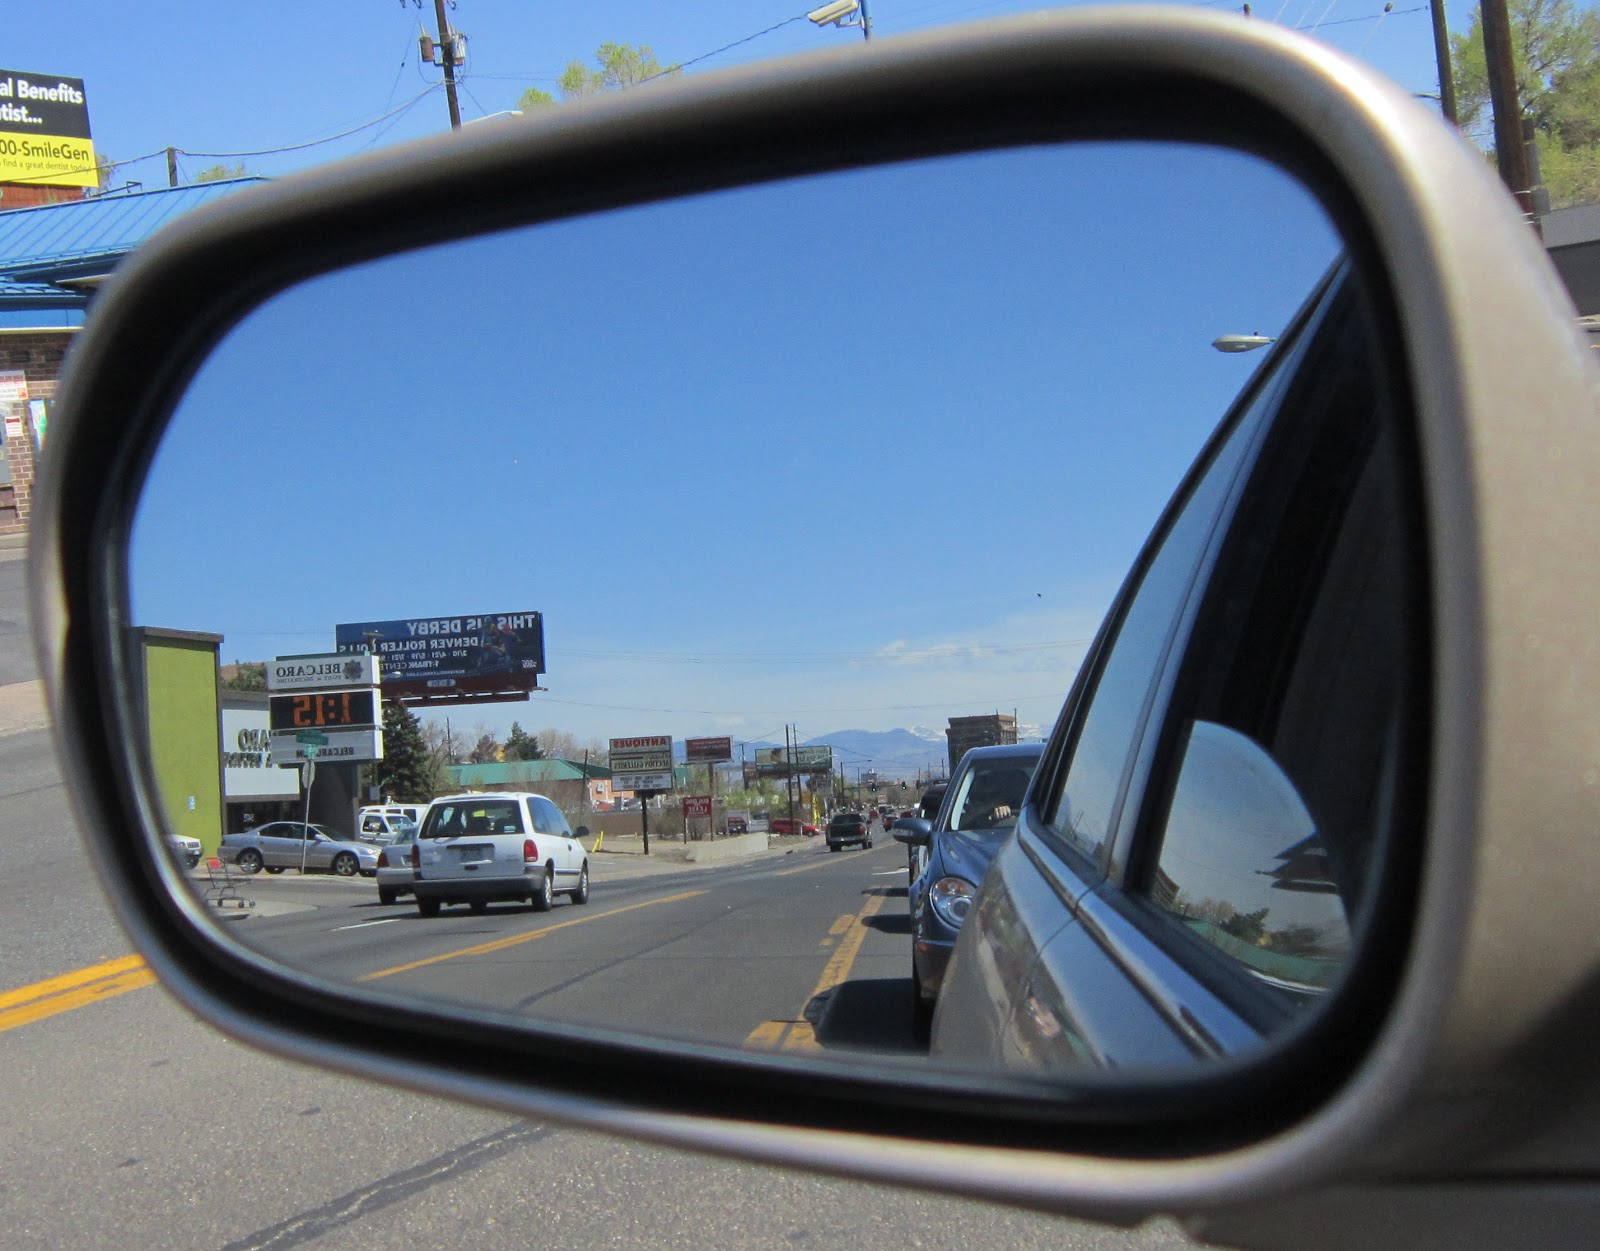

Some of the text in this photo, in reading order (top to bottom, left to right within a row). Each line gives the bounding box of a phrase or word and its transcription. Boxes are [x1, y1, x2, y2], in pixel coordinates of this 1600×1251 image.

[0, 77, 83, 104] al Benefits
[0, 102, 42, 124] tist...
[3, 158, 17, 168] find
[25, 161, 44, 170] great
[46, 162, 69, 171] dentist
